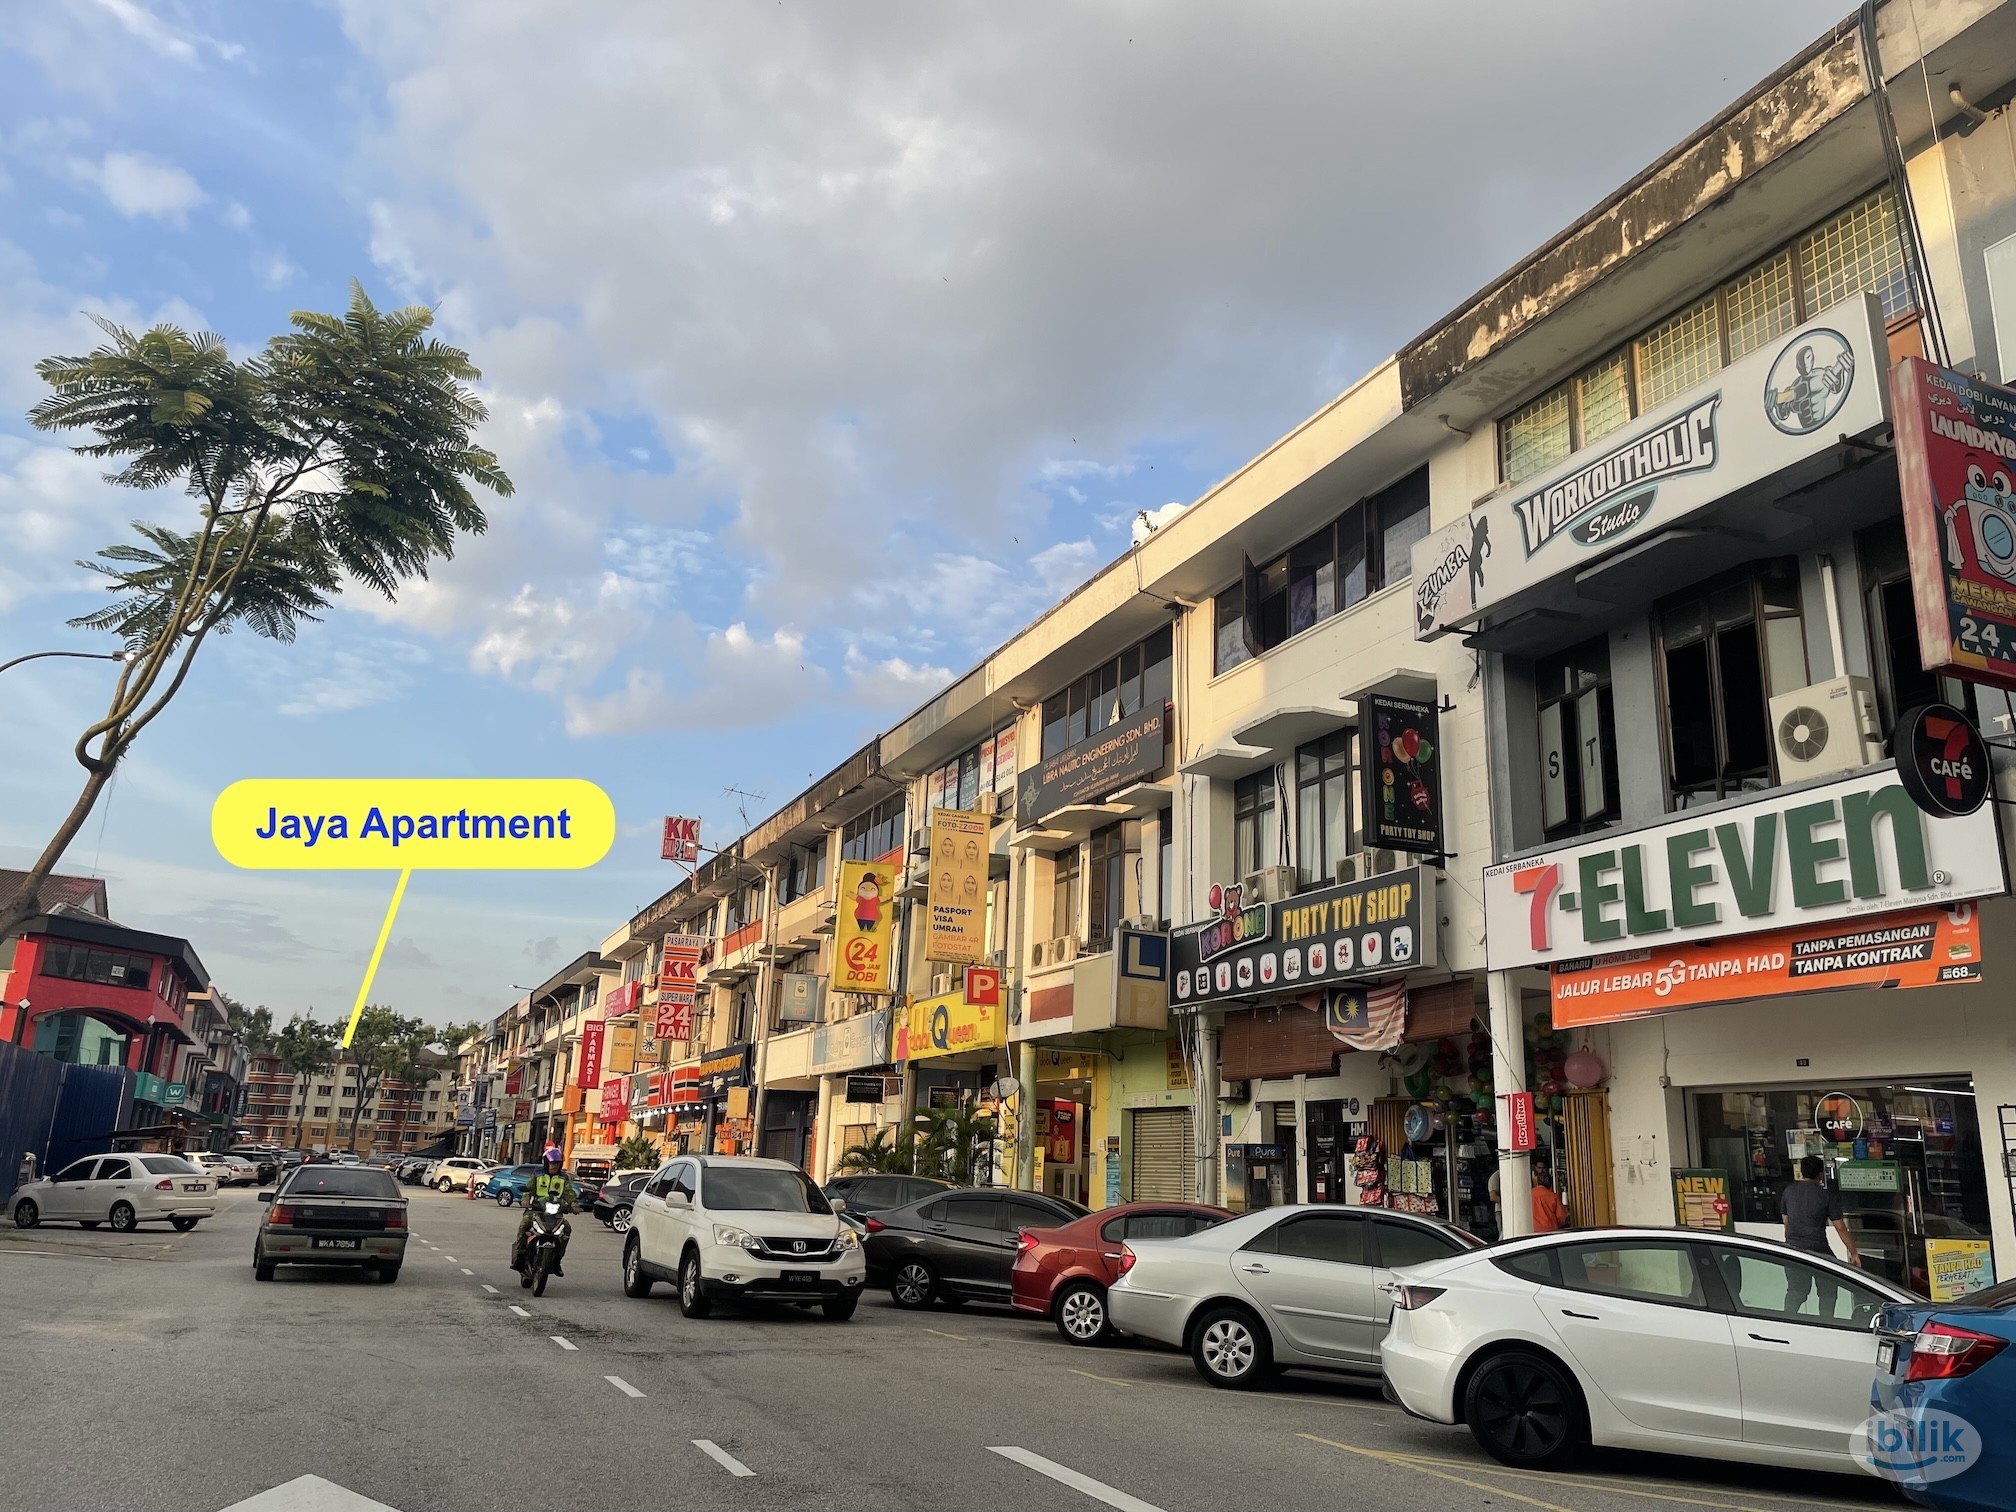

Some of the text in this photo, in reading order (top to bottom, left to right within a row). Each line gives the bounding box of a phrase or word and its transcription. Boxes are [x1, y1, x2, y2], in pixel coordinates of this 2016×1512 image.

[1925, 373, 1957, 393] KEDAI
[1958, 386, 1983, 403] DOBI
[1518, 399, 1721, 552] WORKOUTHOLIC
[1586, 503, 1640, 544] Studio
[1418, 544, 1470, 607] ZUMBA
[1959, 616, 2000, 648] 24
[1375, 698, 1393, 708] KEDAI
[1081, 734, 1125, 767] ENGINEERING
[666, 817, 696, 840] KK
[1380, 824, 1402, 838] PARTY
[1403, 826, 1417, 840] TOY
[1418, 829, 1436, 842] SHOP
[1485, 857, 1545, 878] KEDAI SERBANEKA
[933, 905, 972, 916] PASPORT
[1282, 882, 1412, 943] PARTY TOY SHOP
[1846, 903, 1865, 914] Dimiliki
[1880, 897, 1903, 909] 7-Eleven
[1903, 893, 1927, 908] Malaysia
[1927, 891, 1940, 901] Sdn.
[933, 914, 954, 924] VISA
[933, 923, 964, 934] UMRAH
[932, 933, 967, 943] GAMBAR
[932, 942, 972, 951] FOTOSTAT
[1795, 925, 1930, 955] TANPA PEMASANGAN
[851, 942, 879, 962] 24
[1128, 936, 1160, 977] L
[1795, 943, 1925, 974] TANPA KONTRAK
[663, 961, 696, 978] KK
[1558, 959, 1591, 973] BAHARU
[1602, 954, 1627, 966] HOME
[1952, 966, 1969, 978] 68
[846, 970, 878, 983] DOBI
[1557, 952, 1785, 1000] JALUR LEBAR 5G TANPA HAD
[973, 974, 995, 999] P
[658, 1004, 691, 1026] 24
[586, 1023, 604, 1031] BIG
[656, 1025, 689, 1040] JAM
[586, 1032, 597, 1083] FARMASI
[1227, 1148, 1241, 1158] Pure
[1255, 1146, 1276, 1157] Pure
[1676, 1177, 1724, 1193] NEW
[1933, 1260, 1963, 1275] TANPA
[1964, 1256, 1984, 1270] HAD
